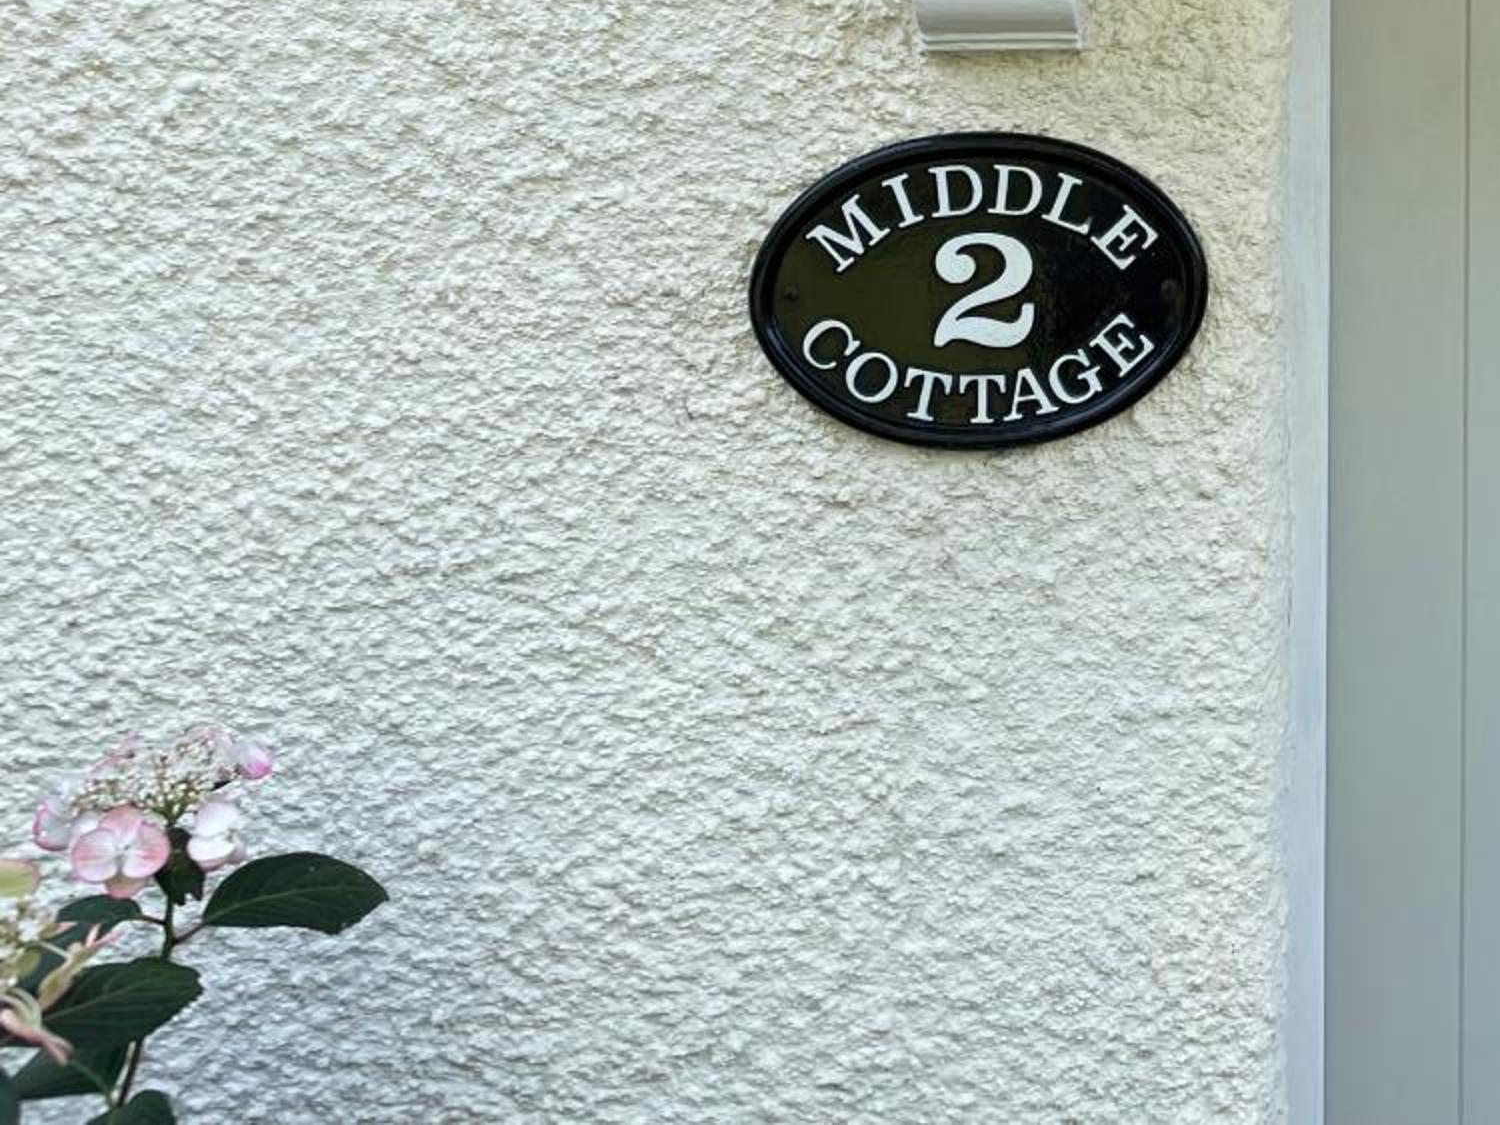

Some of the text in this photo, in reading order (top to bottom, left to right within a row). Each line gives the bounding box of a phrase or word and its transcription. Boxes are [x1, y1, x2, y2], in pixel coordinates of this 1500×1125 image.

[805, 164, 1159, 273] MIDDLE
[933, 232, 1035, 348] 2
[802, 312, 1155, 424] COTTAGE
